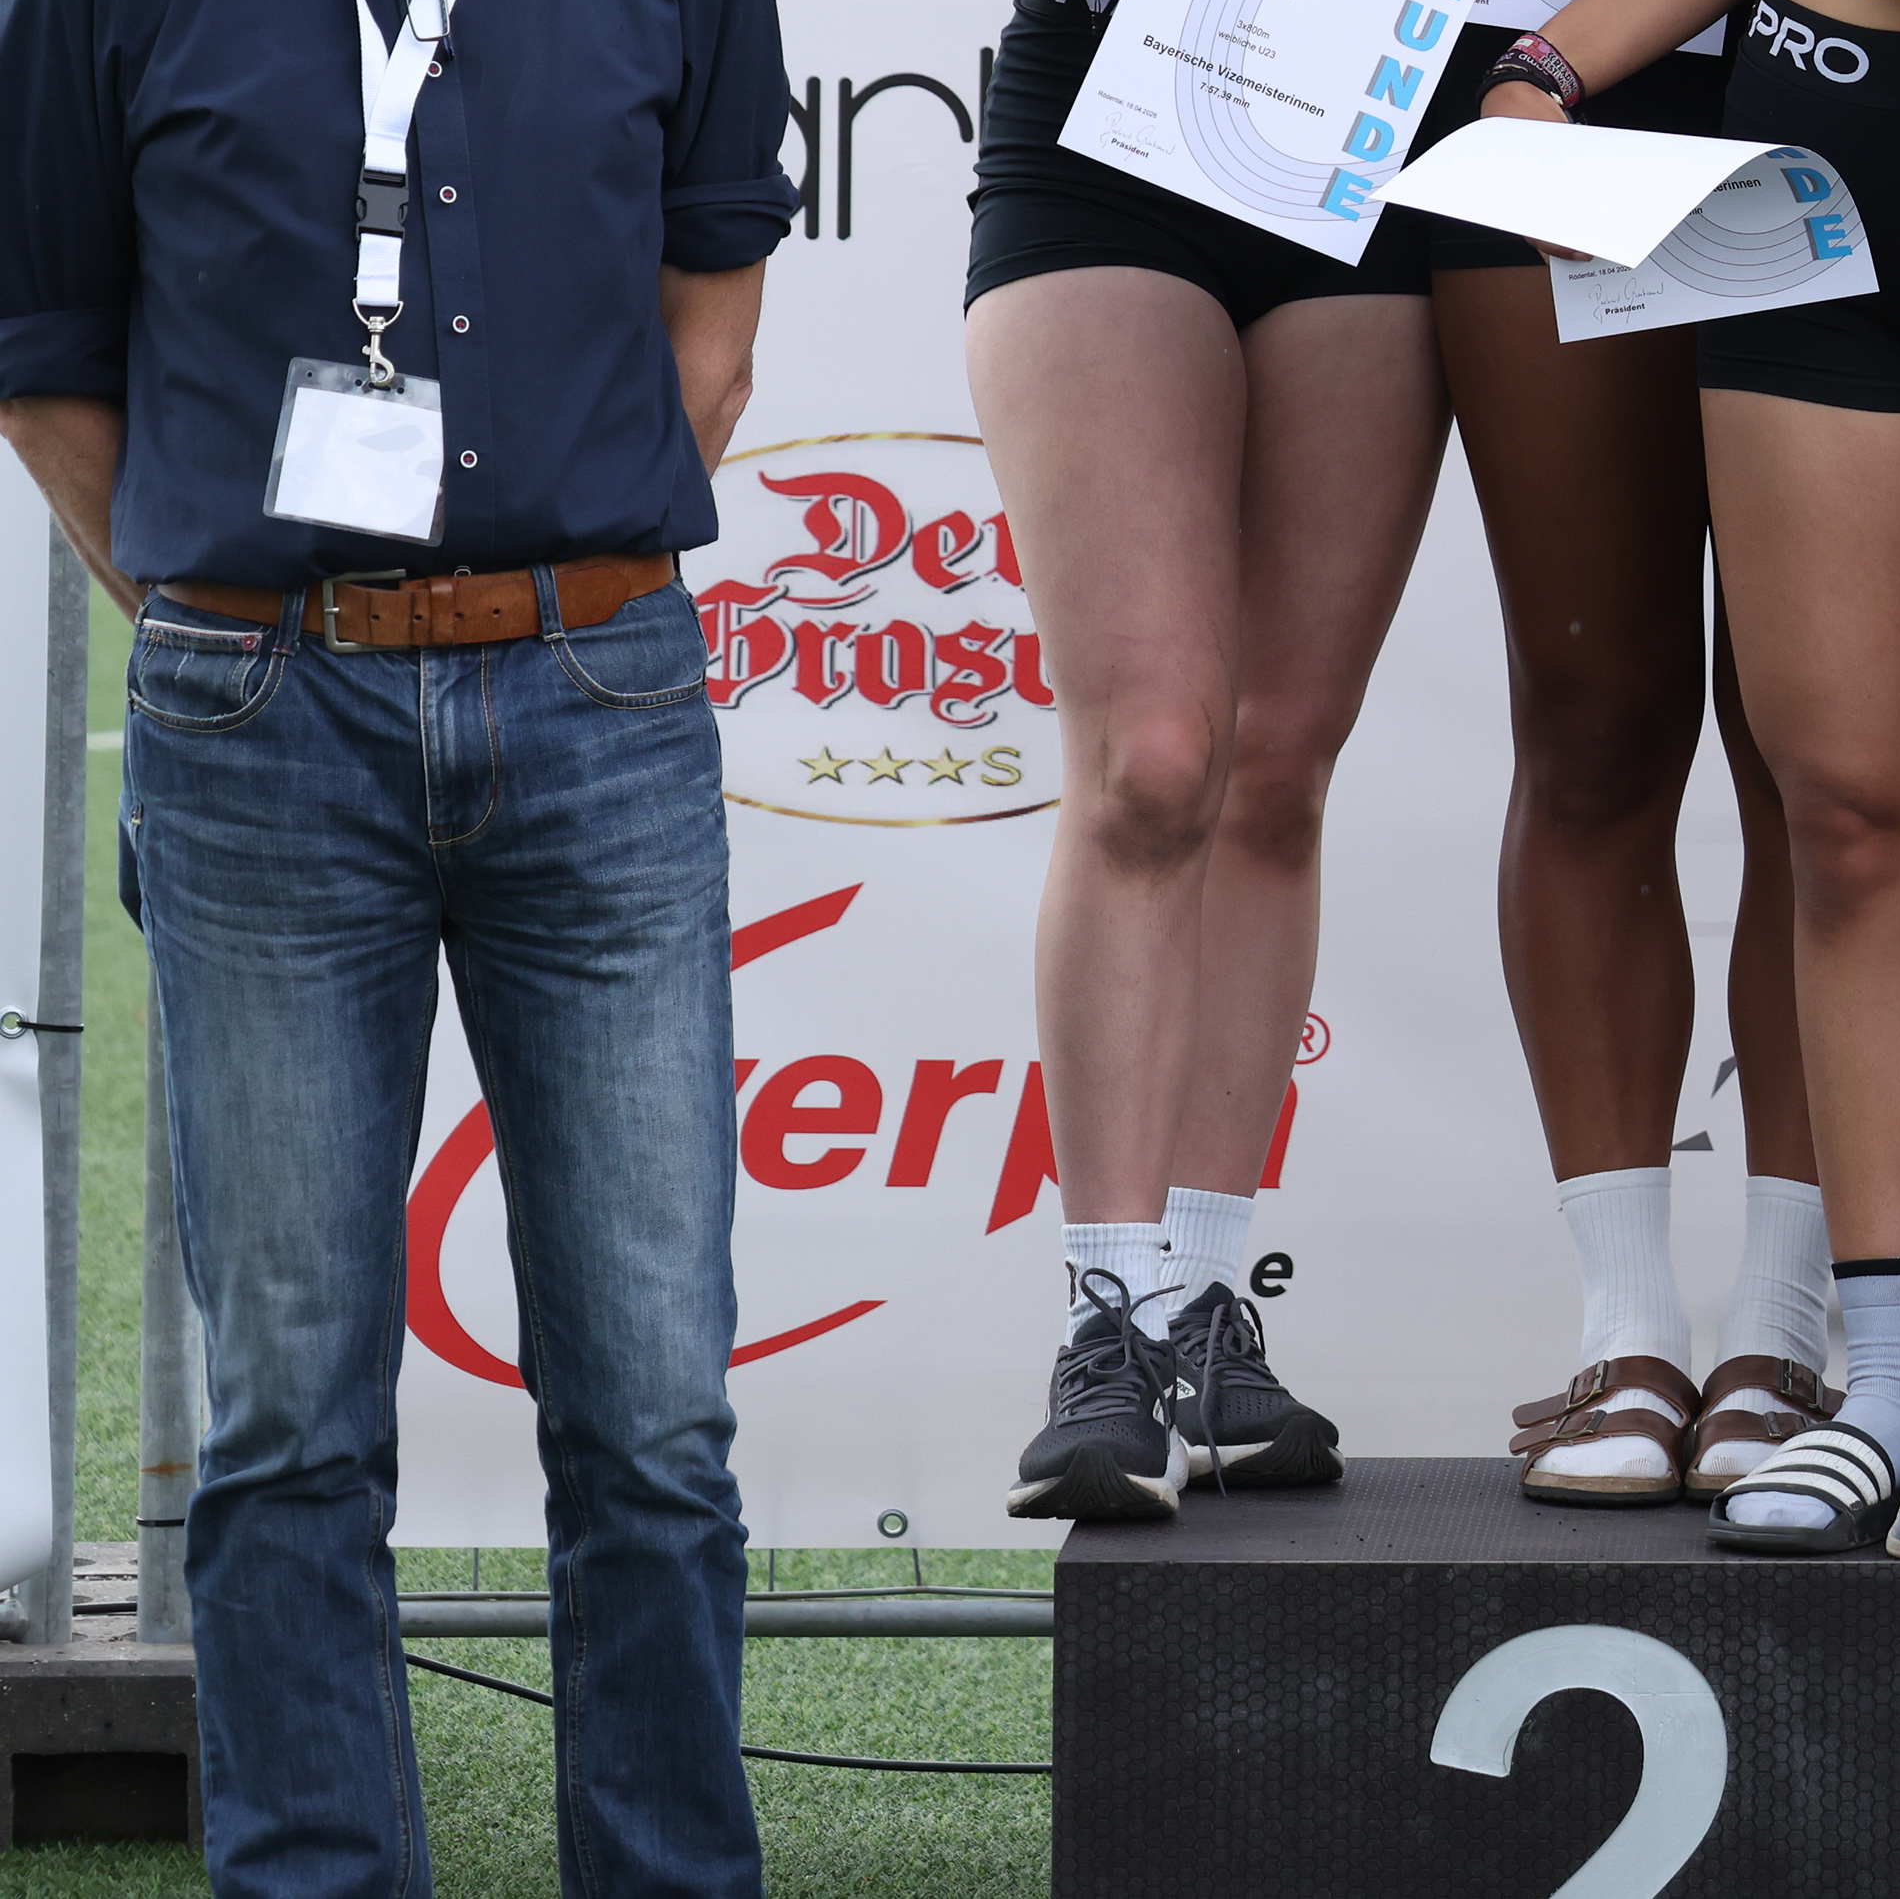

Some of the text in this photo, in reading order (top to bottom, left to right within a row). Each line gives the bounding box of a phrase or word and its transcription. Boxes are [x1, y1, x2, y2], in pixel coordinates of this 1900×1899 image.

[1143, 34, 1326, 117] Bayerische Vizemeisterinnen
[1749, 0, 1870, 83] PRO
[1233, 95, 1251, 109] min
